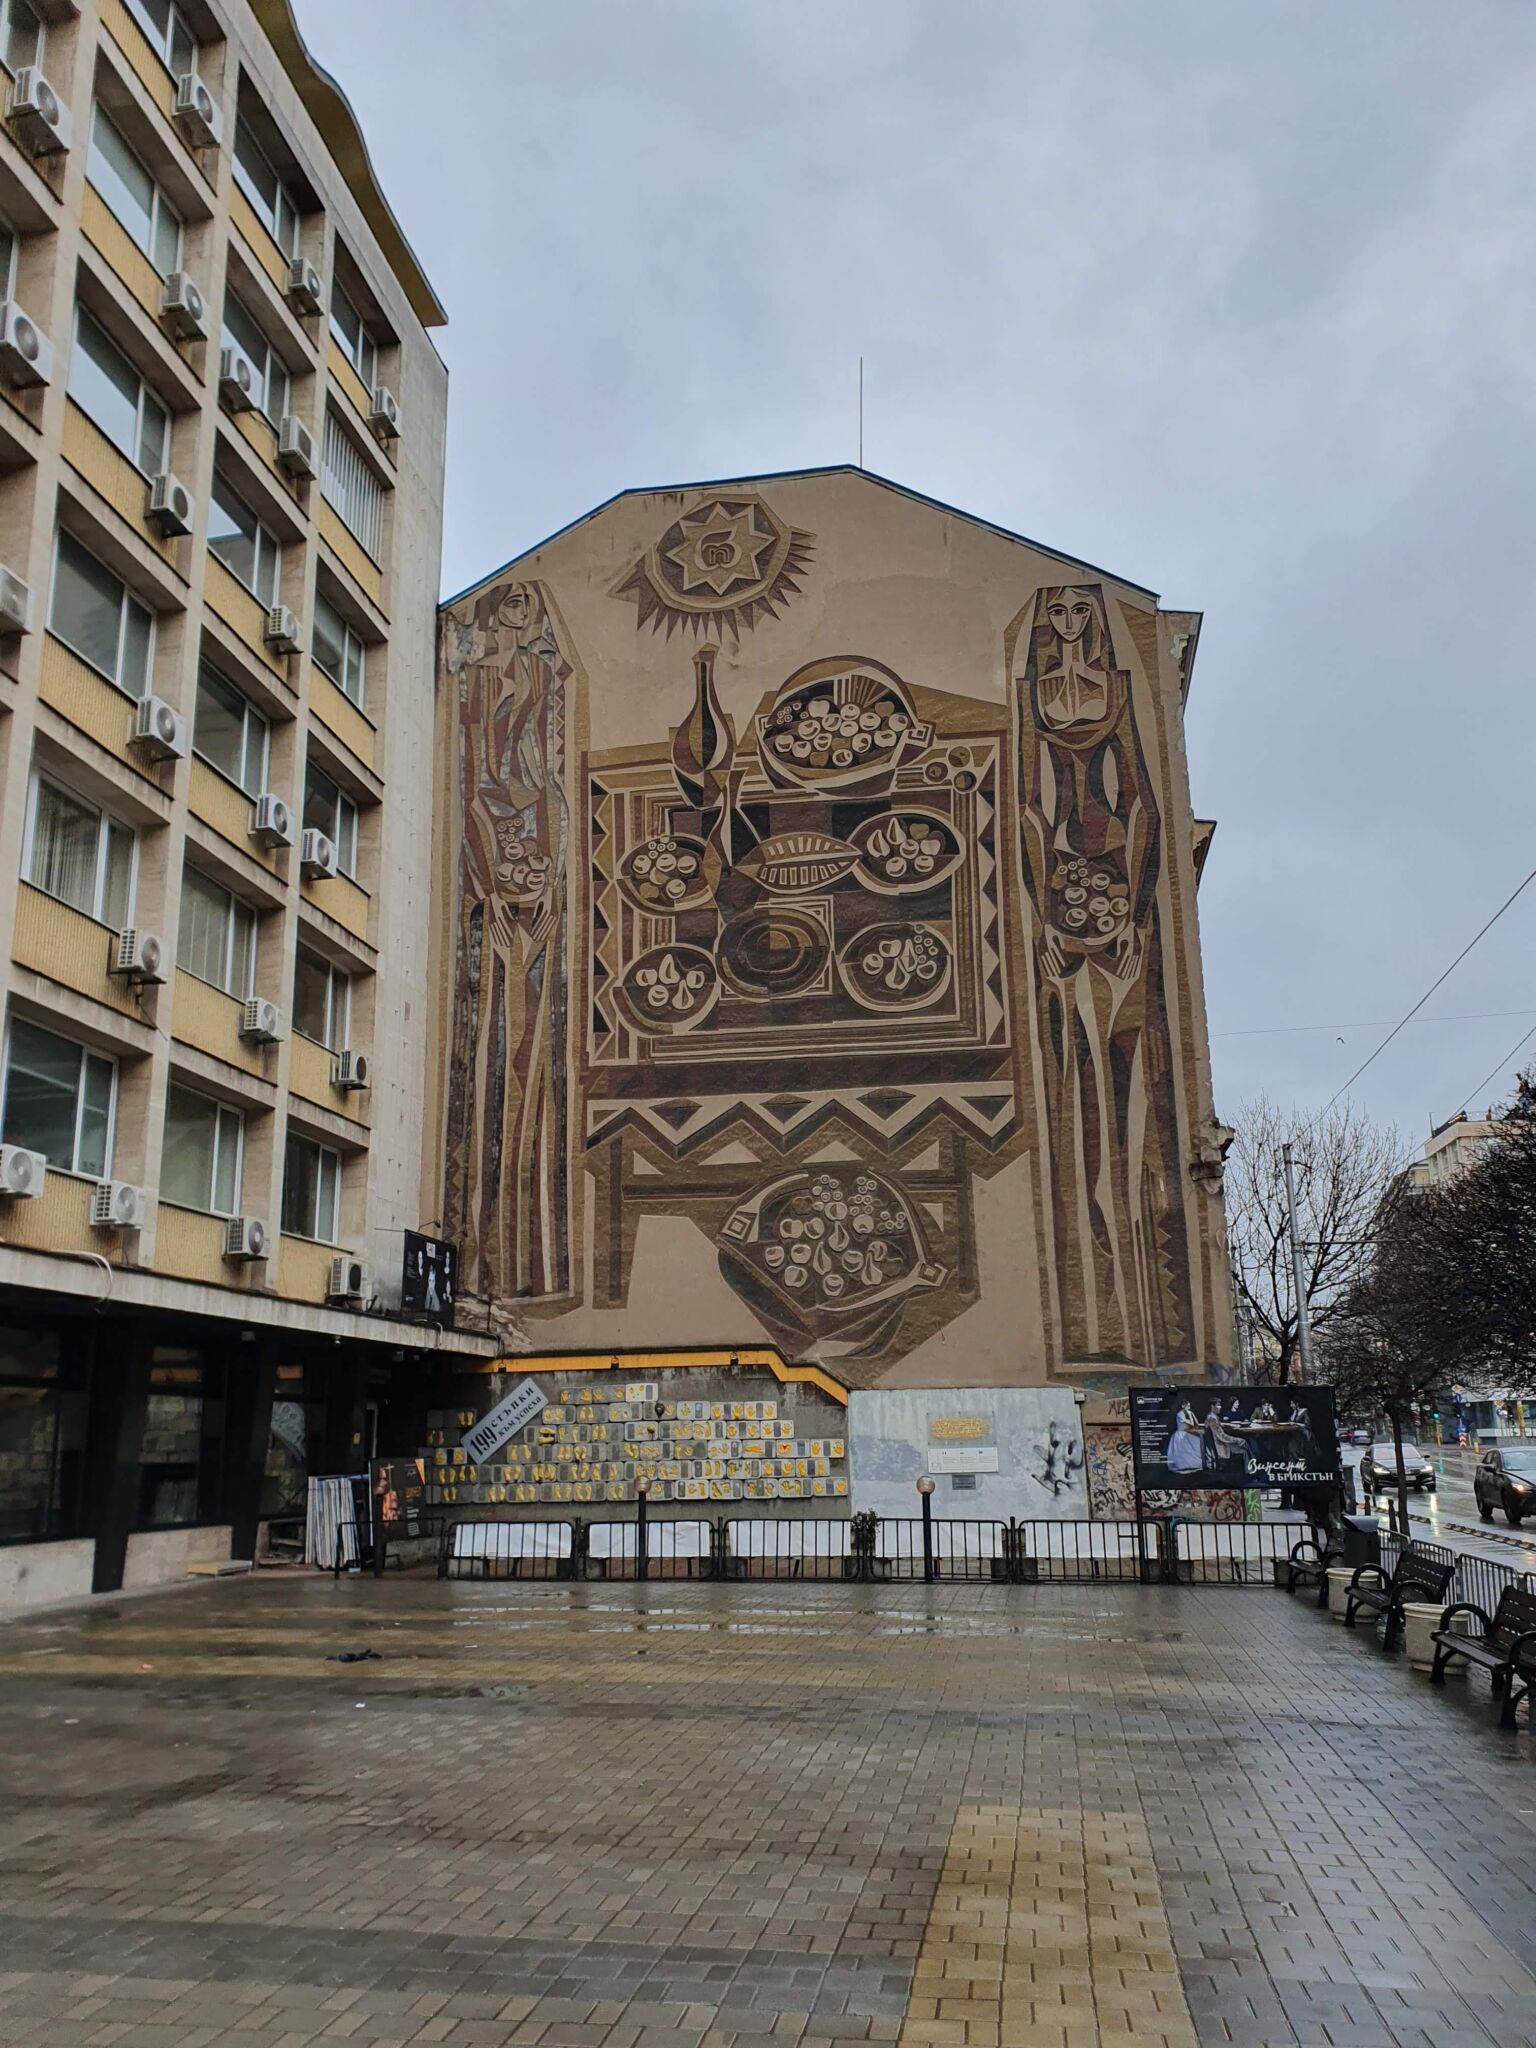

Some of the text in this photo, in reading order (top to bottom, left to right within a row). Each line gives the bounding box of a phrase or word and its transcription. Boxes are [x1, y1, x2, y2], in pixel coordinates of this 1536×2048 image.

[497, 1396, 542, 1437] към успеха
[470, 1426, 498, 1455] 199
[1247, 1458, 1307, 1475] Винсент
[1277, 1472, 1334, 1481] БРИКСТЪН
